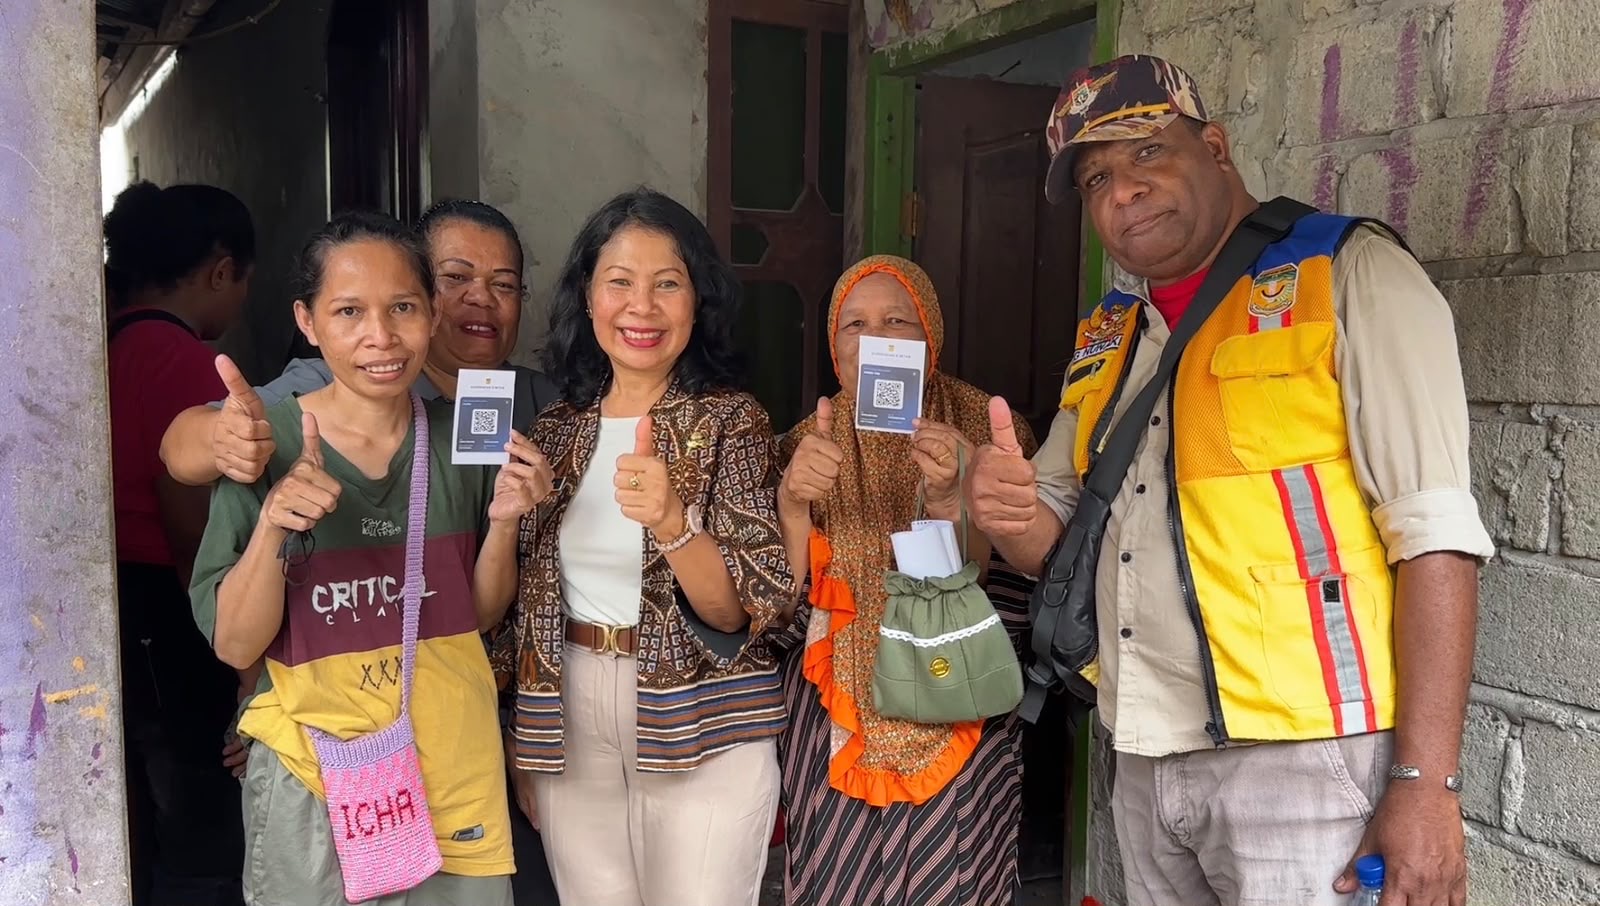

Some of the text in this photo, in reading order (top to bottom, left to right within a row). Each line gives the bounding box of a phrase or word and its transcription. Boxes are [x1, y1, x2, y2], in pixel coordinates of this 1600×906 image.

[312, 575, 438, 614] CRITICL
[326, 603, 402, 626] CLA
[340, 788, 416, 840] ICHA
